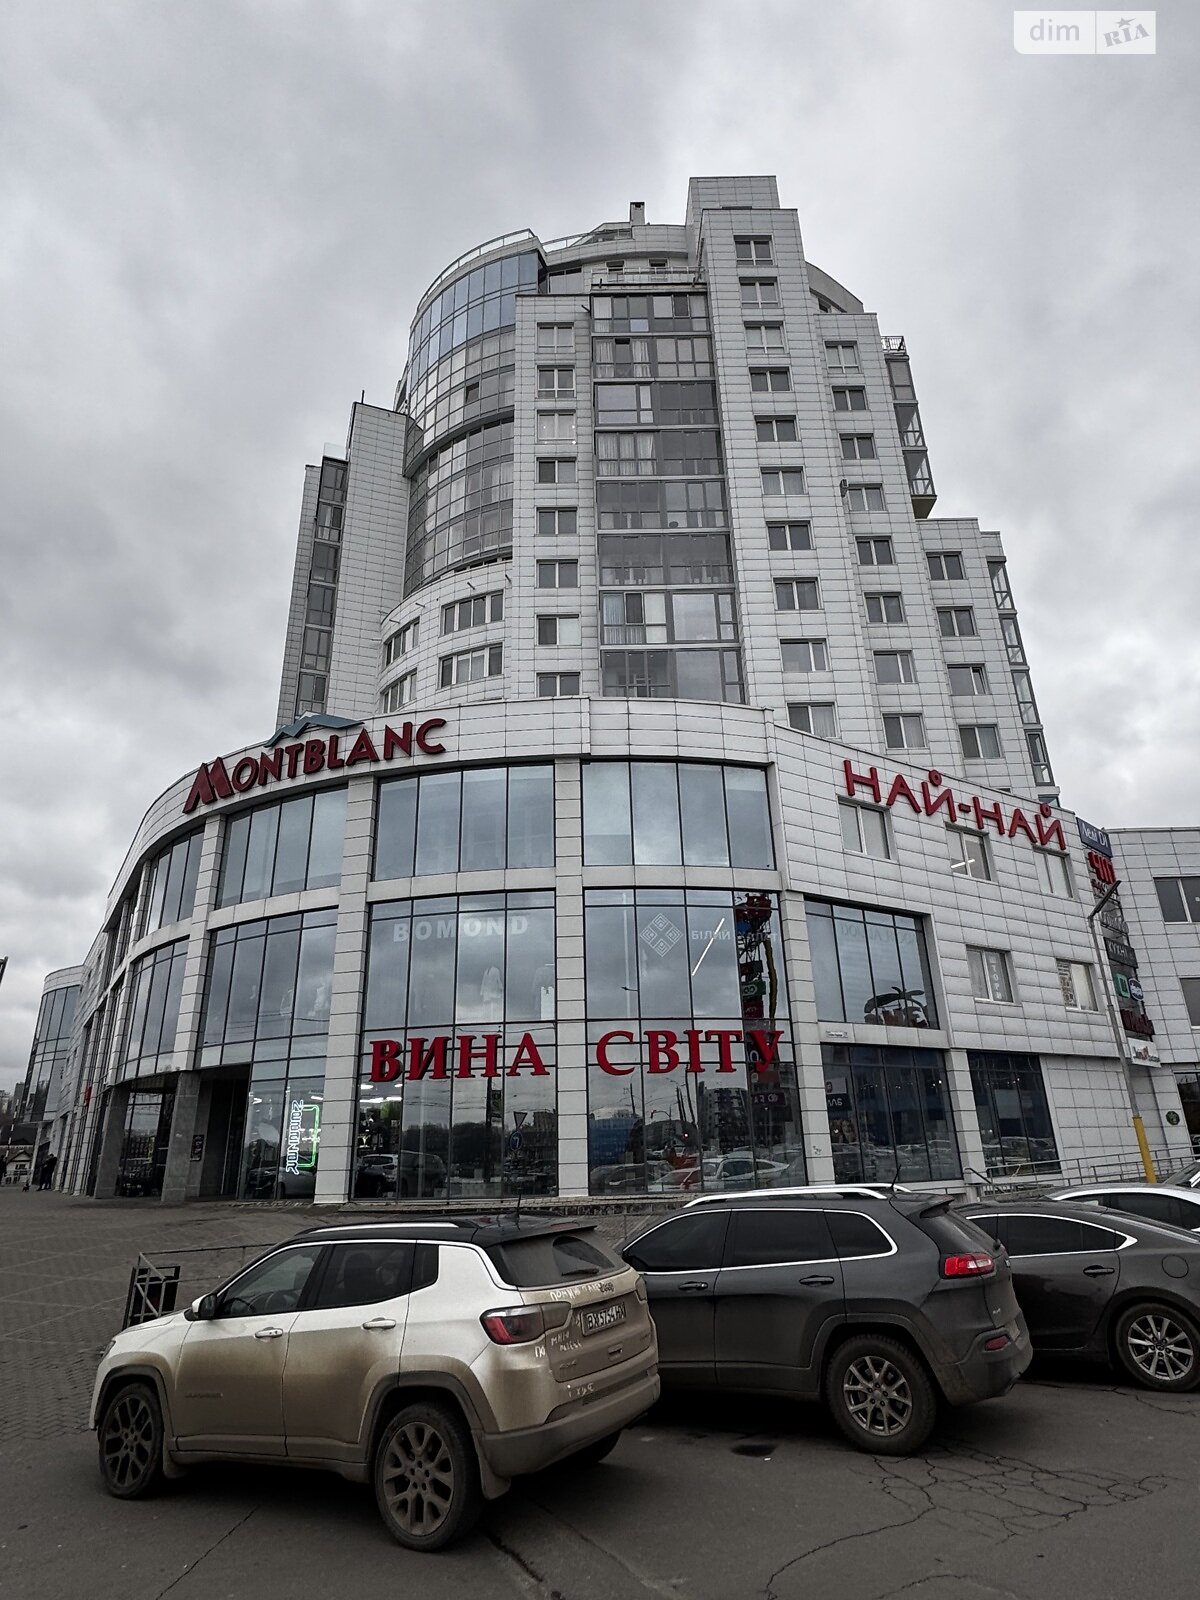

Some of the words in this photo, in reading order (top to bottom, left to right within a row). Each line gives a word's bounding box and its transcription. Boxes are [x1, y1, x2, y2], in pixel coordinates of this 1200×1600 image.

[181, 717, 448, 814] MONTBLANC
[843, 759, 1067, 850] НАЙ-НАЙ
[393, 915, 528, 942] BOMOND
[691, 929, 731, 940] БІЛИЙ
[369, 1032, 551, 1083] ВИНА
[596, 1029, 786, 1076] СВІТУ
